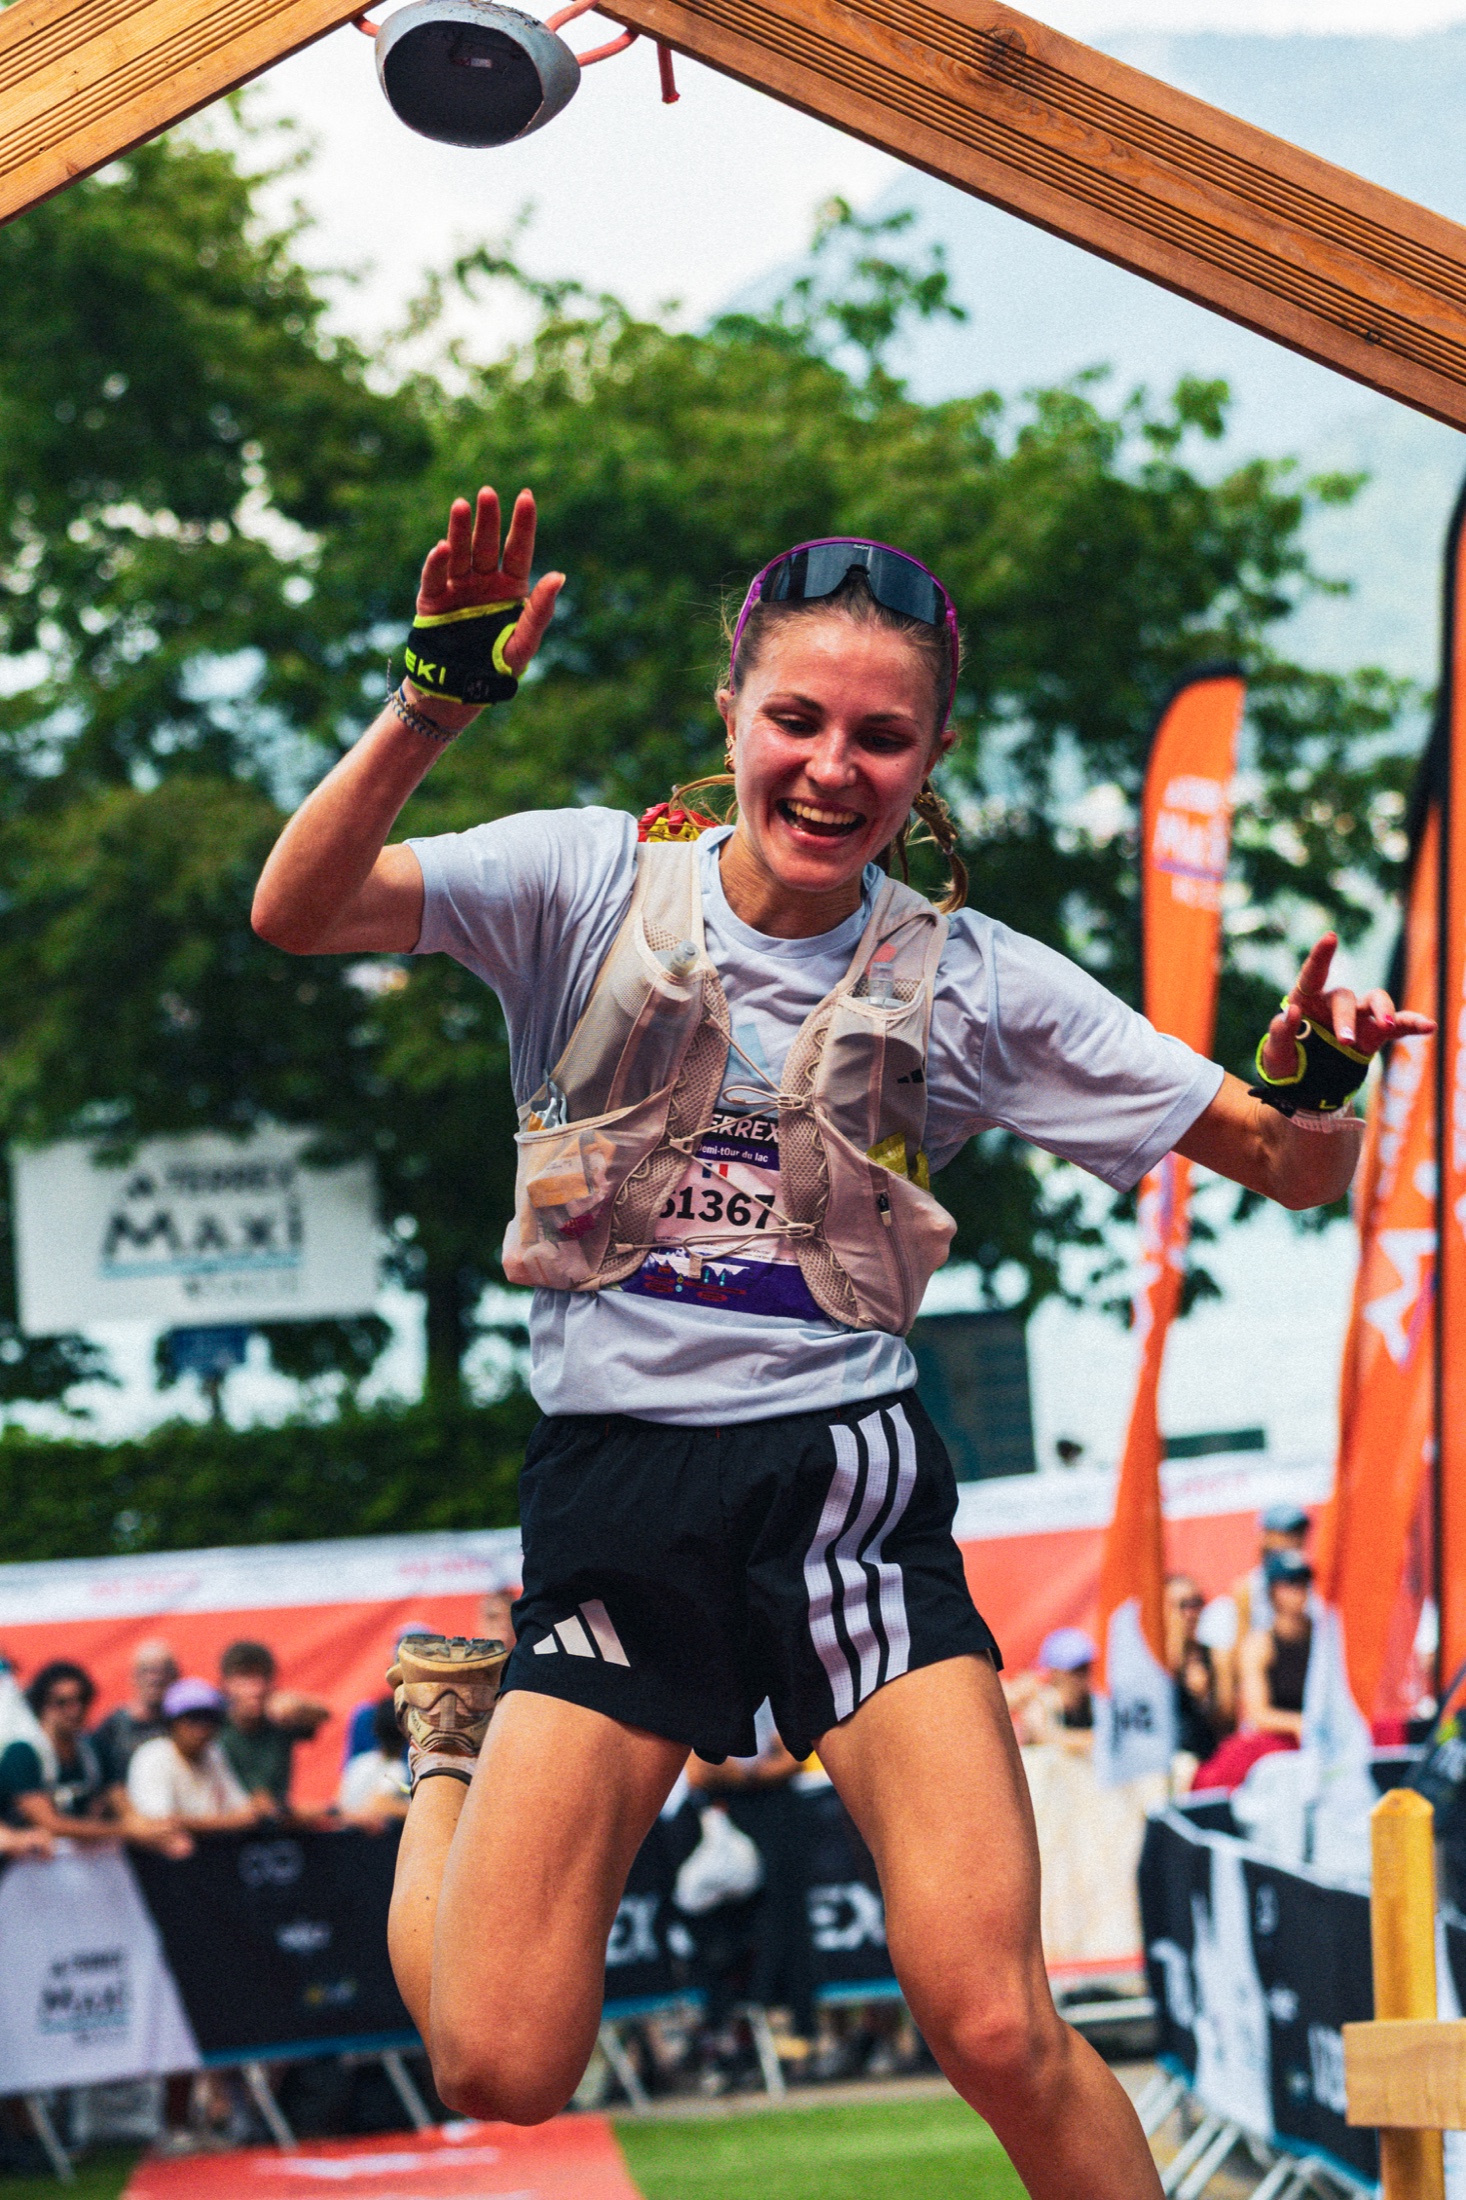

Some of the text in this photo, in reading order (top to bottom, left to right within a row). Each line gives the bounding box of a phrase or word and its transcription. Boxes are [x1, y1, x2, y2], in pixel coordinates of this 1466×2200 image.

[404, 647, 447, 686] EKI
[709, 1113, 779, 1143] ERREX
[701, 1144, 769, 1163] emi-tOur du lac
